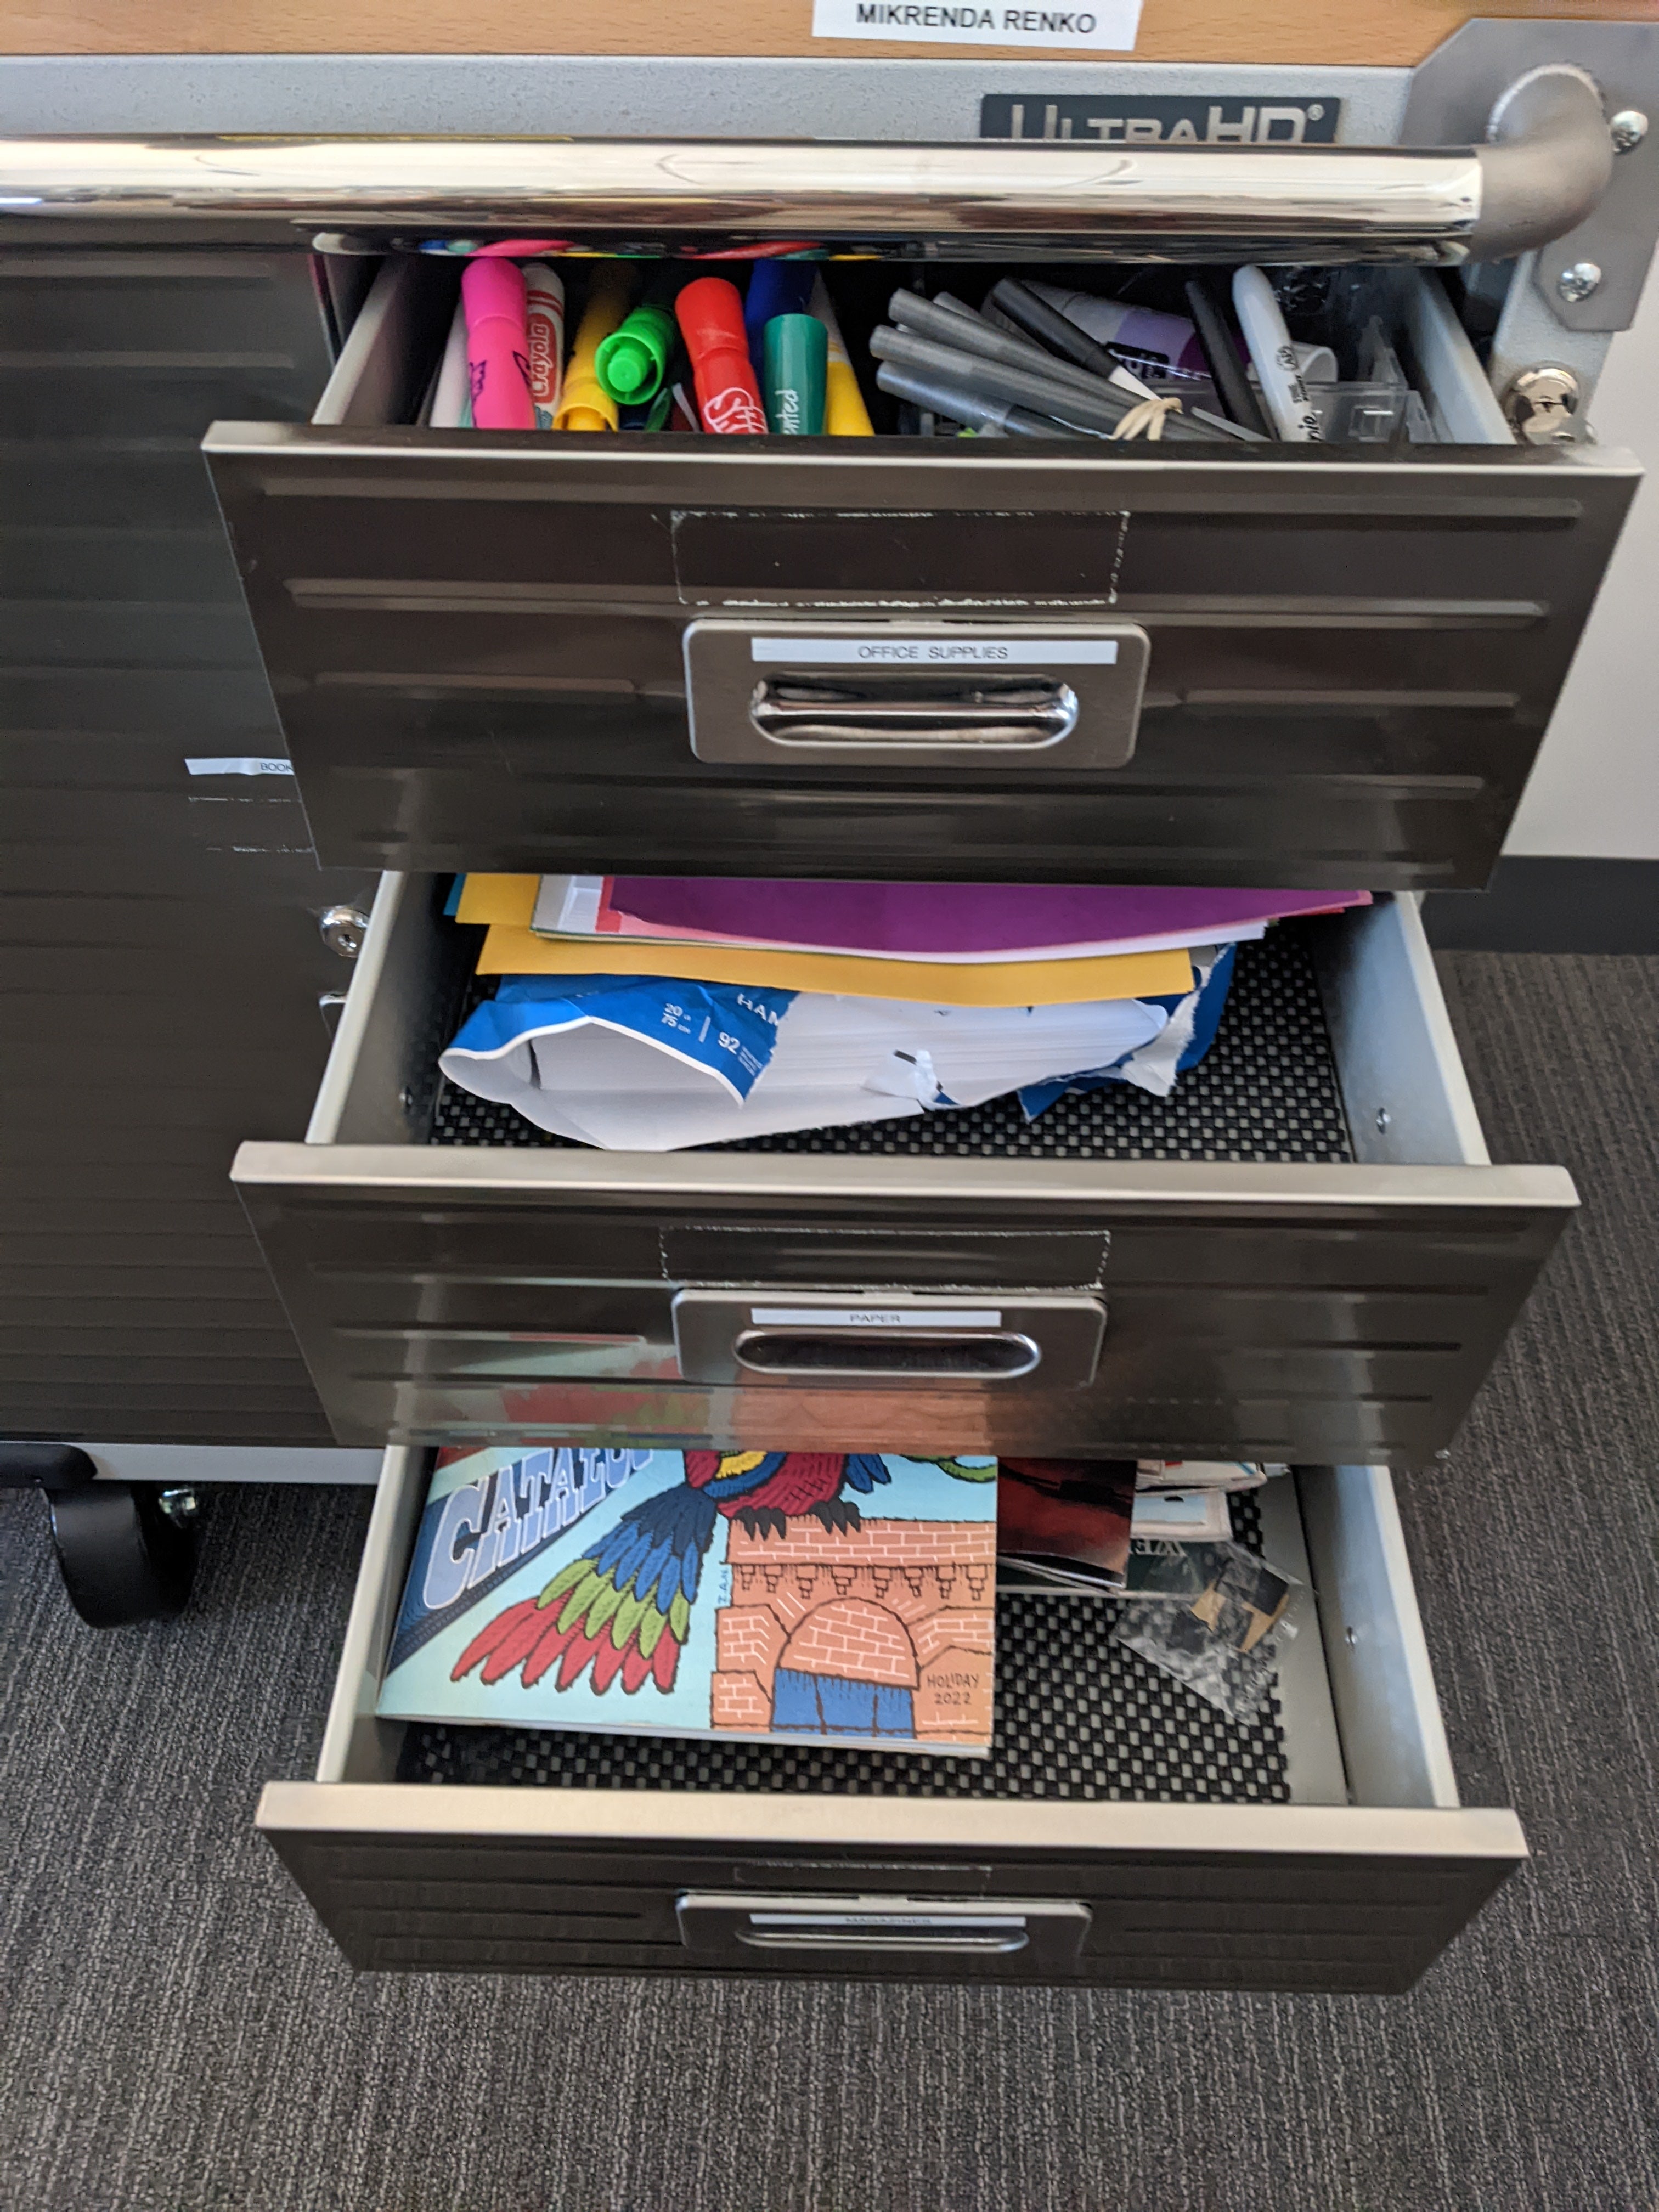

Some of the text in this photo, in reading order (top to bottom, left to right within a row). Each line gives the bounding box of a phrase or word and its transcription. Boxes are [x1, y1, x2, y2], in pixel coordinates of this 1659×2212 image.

[856, 2, 1097, 34] MIKRENDA RENKO
[527, 323, 553, 397] Crayola
[857, 646, 1008, 659] OFFICE SUPPLIES
[718, 1031, 740, 1055] 92
[849, 1313, 900, 1323] PAPER
[927, 1672, 979, 1689] HOLIDAY
[934, 1691, 972, 1705] 2022
